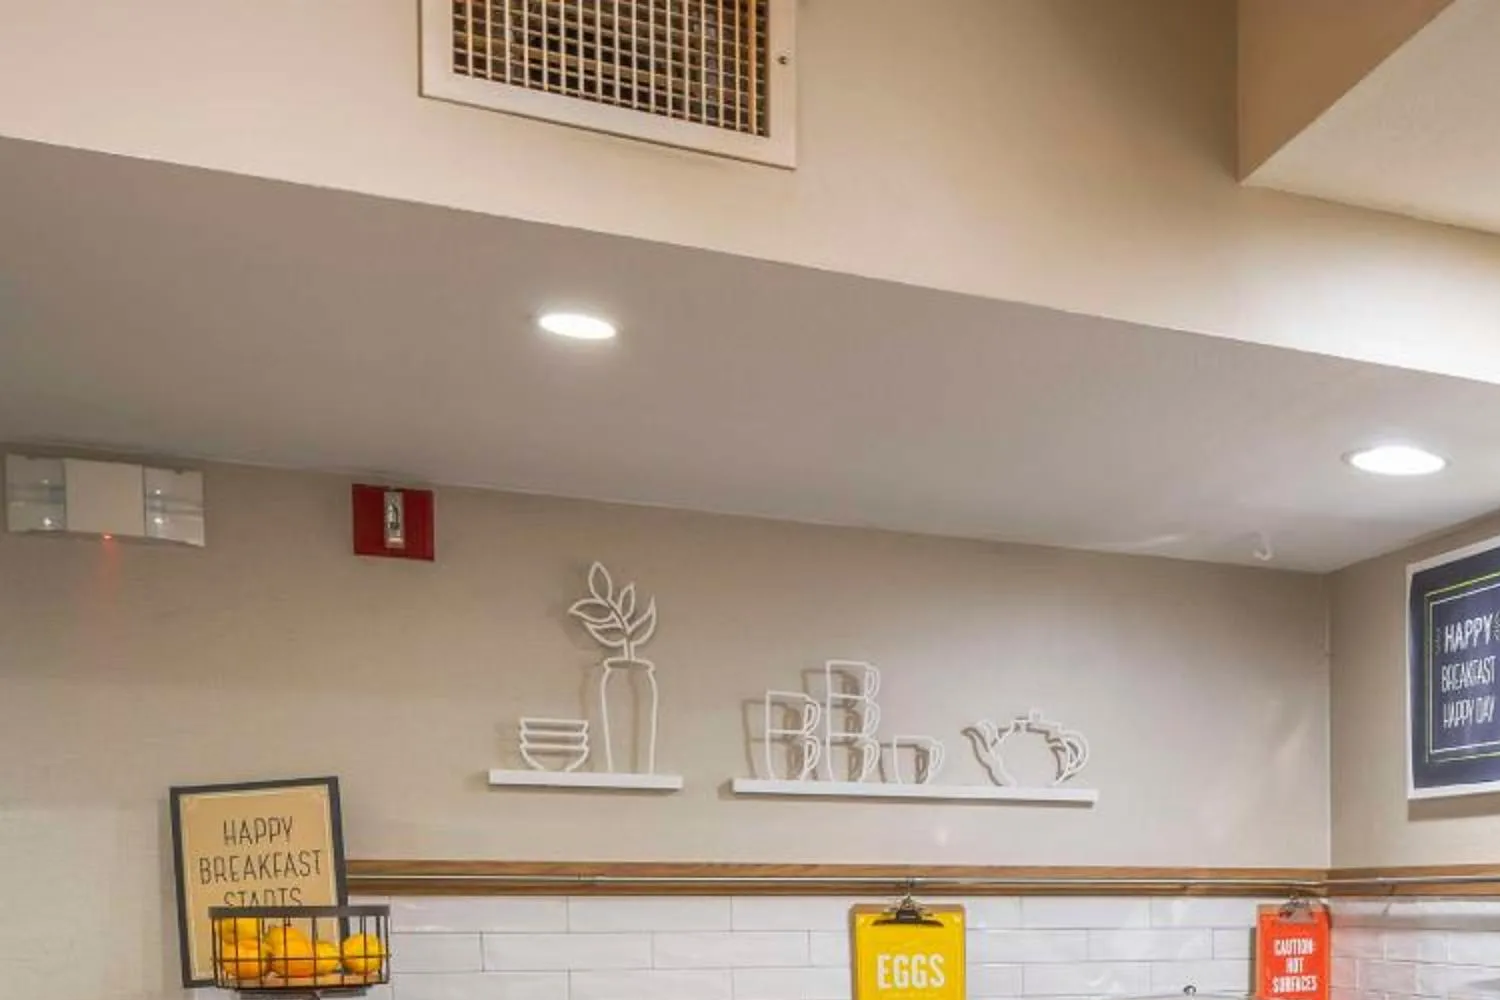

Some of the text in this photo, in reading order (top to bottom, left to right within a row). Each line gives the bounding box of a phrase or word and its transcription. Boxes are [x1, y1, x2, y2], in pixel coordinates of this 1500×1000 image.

[1444, 613, 1493, 653] HAPPY
[1441, 655, 1496, 692] BREAKFAST
[1443, 696, 1496, 728] HAPPY DAY
[223, 816, 293, 845] HAPPY
[199, 849, 321, 885] BREAKFAST
[1273, 938, 1314, 956] CAUTION
[877, 953, 945, 989] EGGS
[1286, 957, 1304, 974] HOT
[1272, 975, 1317, 993] SURFACES
